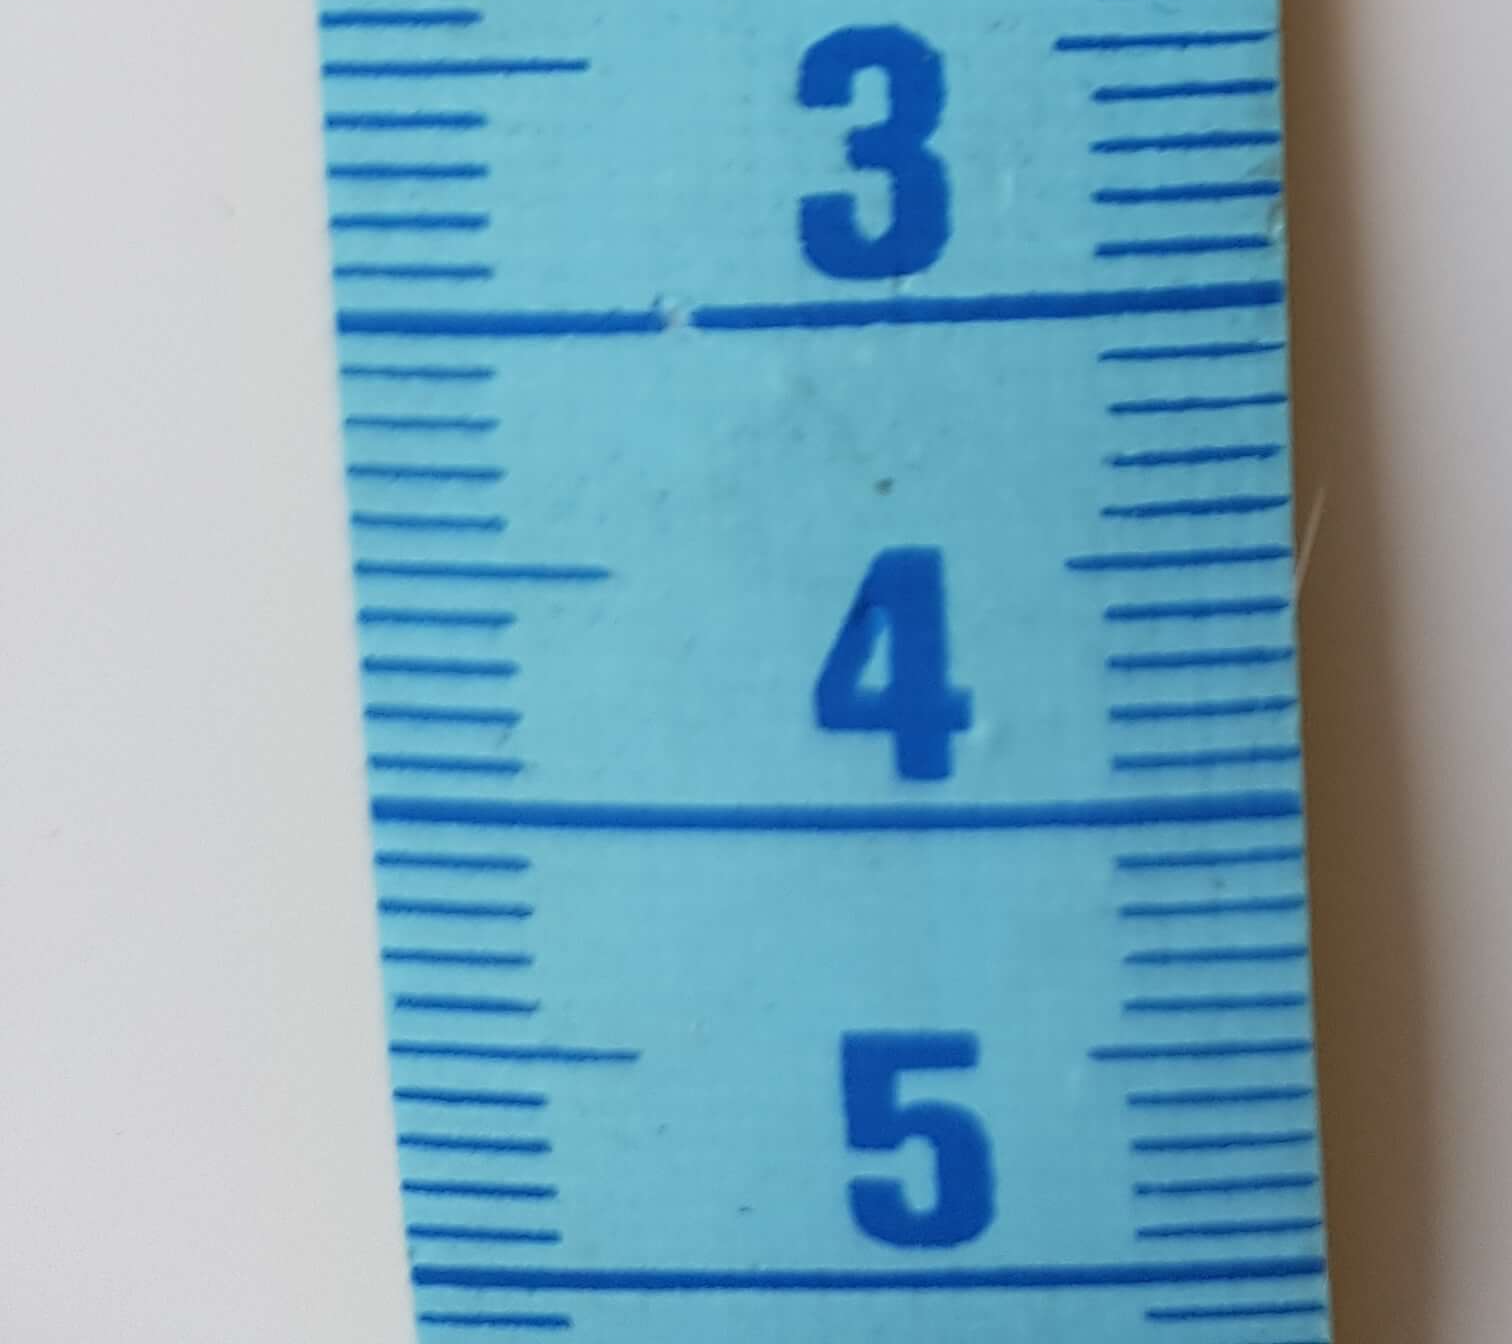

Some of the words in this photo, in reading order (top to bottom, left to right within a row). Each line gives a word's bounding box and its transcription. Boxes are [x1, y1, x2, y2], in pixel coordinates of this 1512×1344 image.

[797, 22, 954, 283] 3
[811, 544, 975, 786] 4
[838, 1028, 998, 1254] 5
